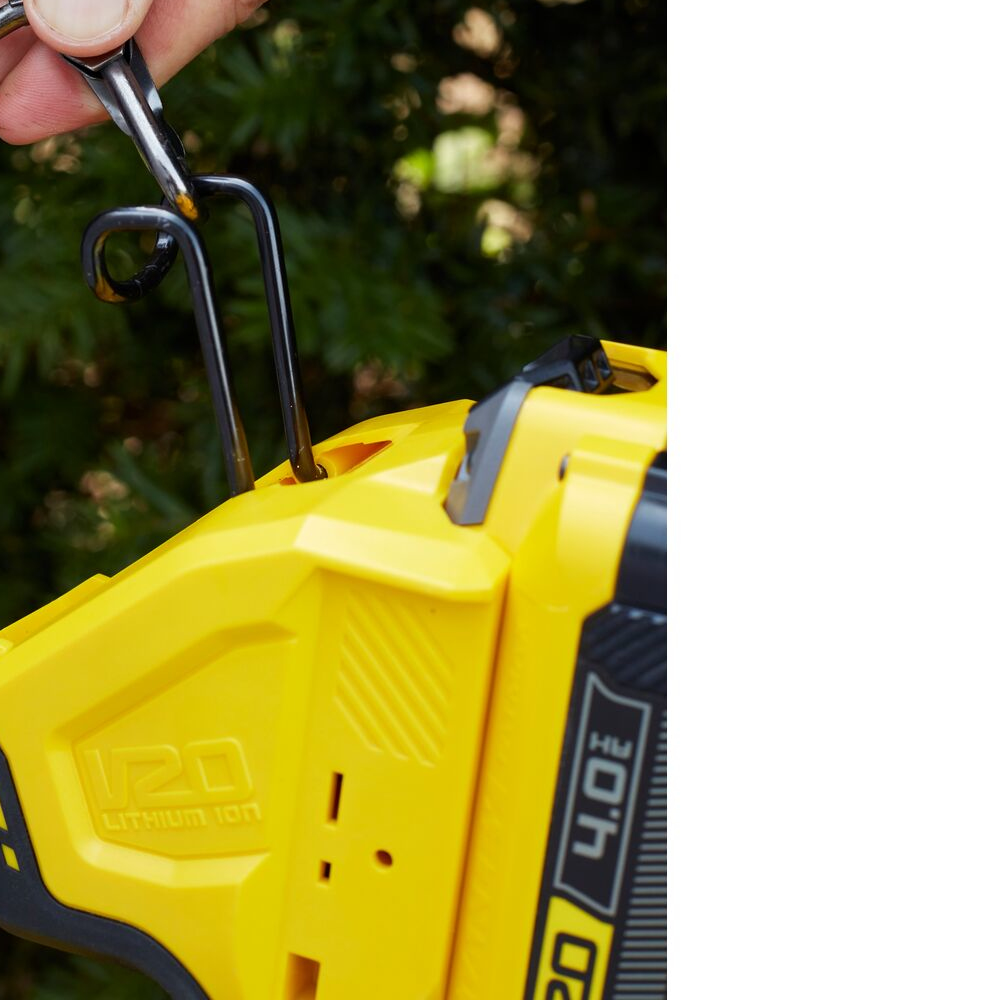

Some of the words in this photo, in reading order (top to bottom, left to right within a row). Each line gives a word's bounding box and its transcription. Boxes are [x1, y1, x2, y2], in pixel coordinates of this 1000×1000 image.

[83, 736, 254, 810] V20
[572, 757, 628, 859] 4.0
[101, 807, 207, 831] LITHIUM
[214, 802, 263, 824] ION
